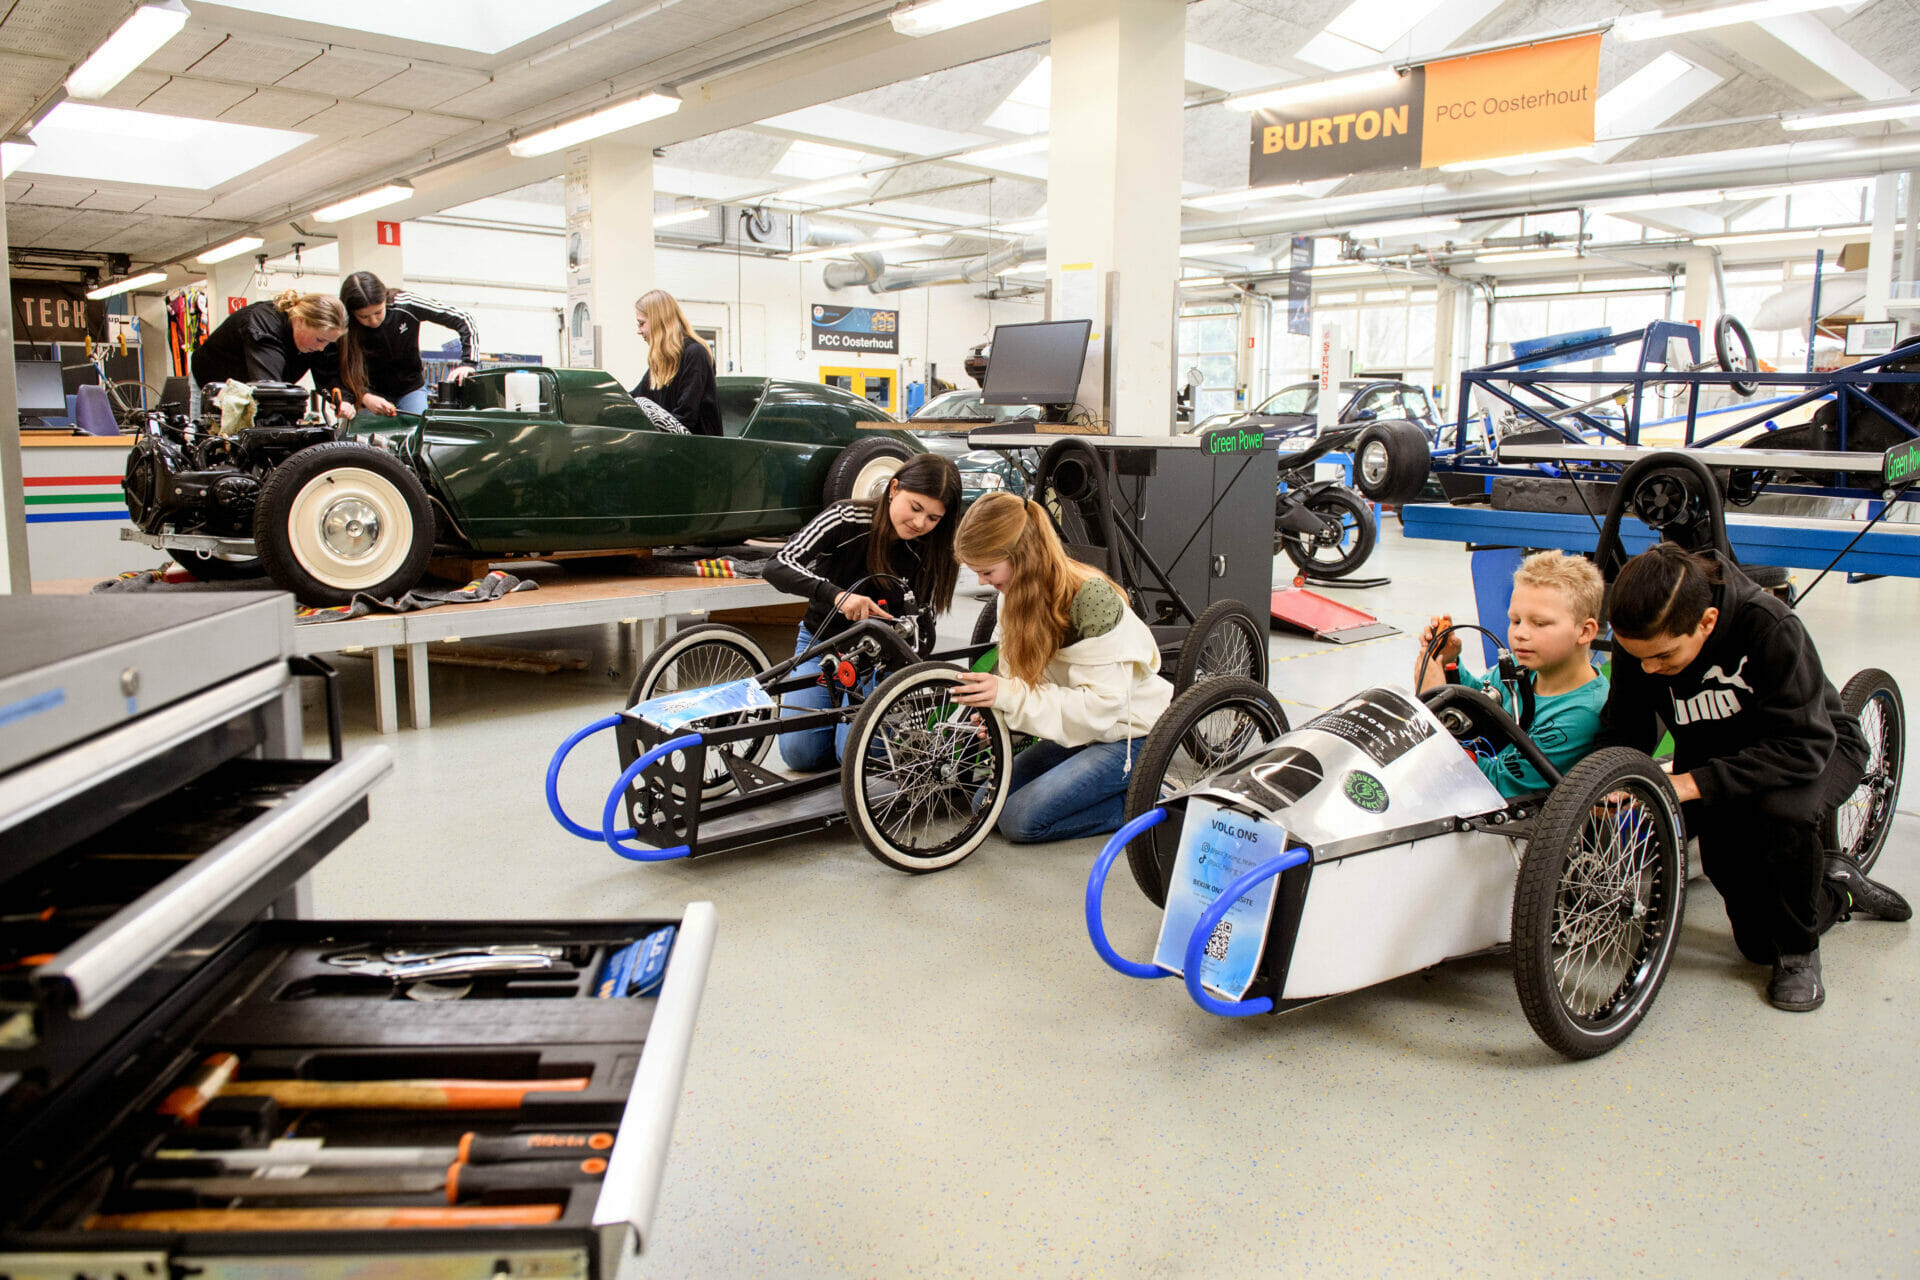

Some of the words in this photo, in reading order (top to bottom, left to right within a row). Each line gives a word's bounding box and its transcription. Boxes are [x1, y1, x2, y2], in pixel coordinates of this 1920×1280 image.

[1436, 100, 1478, 122] PCC
[1483, 84, 1589, 116] Oosterhout
[1262, 104, 1410, 155] BURTON
[22, 297, 86, 329] TECH
[818, 334, 840, 346] PCC
[841, 335, 894, 349] Oosterhout
[1210, 432, 1237, 454] Green
[1238, 429, 1265, 451] Power
[1887, 453, 1908, 481] Green
[1669, 686, 1742, 726] UMA
[1211, 819, 1235, 837] VOLG
[1236, 827, 1258, 844] ONS
